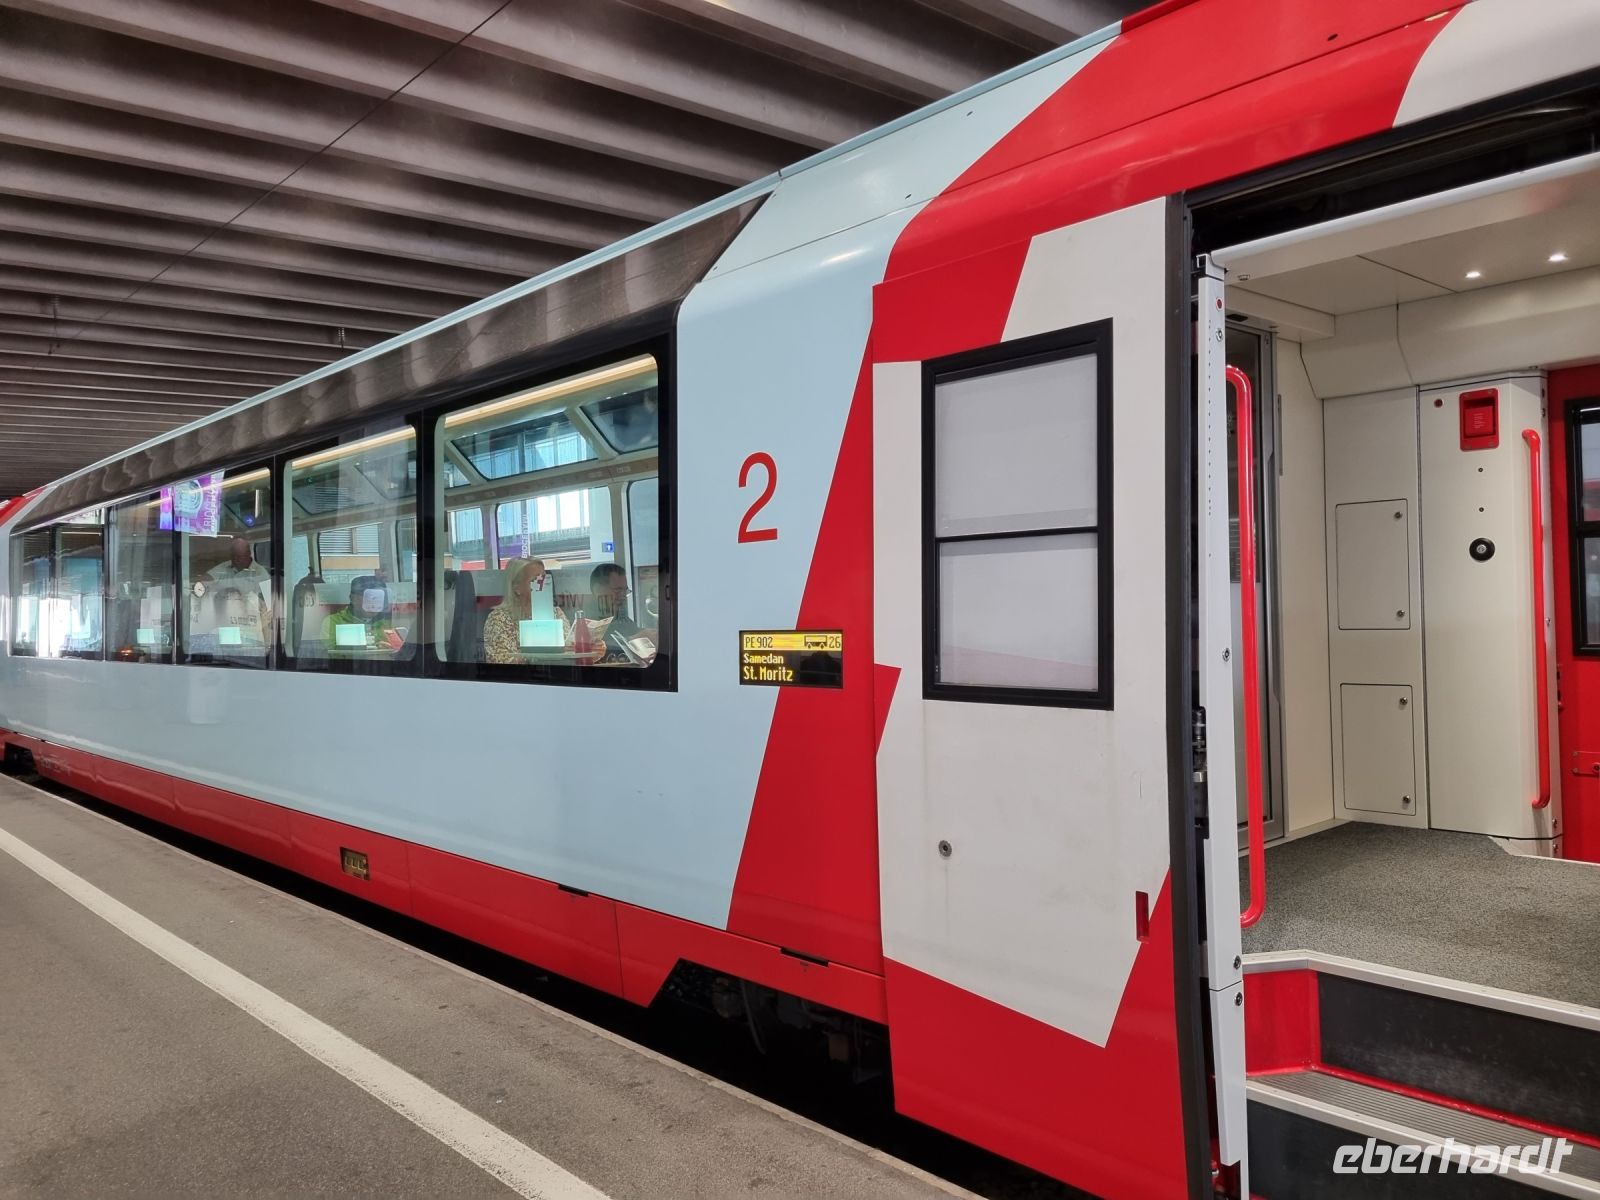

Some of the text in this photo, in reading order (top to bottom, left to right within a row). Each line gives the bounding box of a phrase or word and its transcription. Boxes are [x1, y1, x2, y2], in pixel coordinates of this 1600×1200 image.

[738, 451, 777, 543] 2
[756, 636, 773, 649] 902
[828, 636, 841, 649] 26
[743, 653, 784, 665] Samedan
[743, 666, 793, 681] St. Moritz
